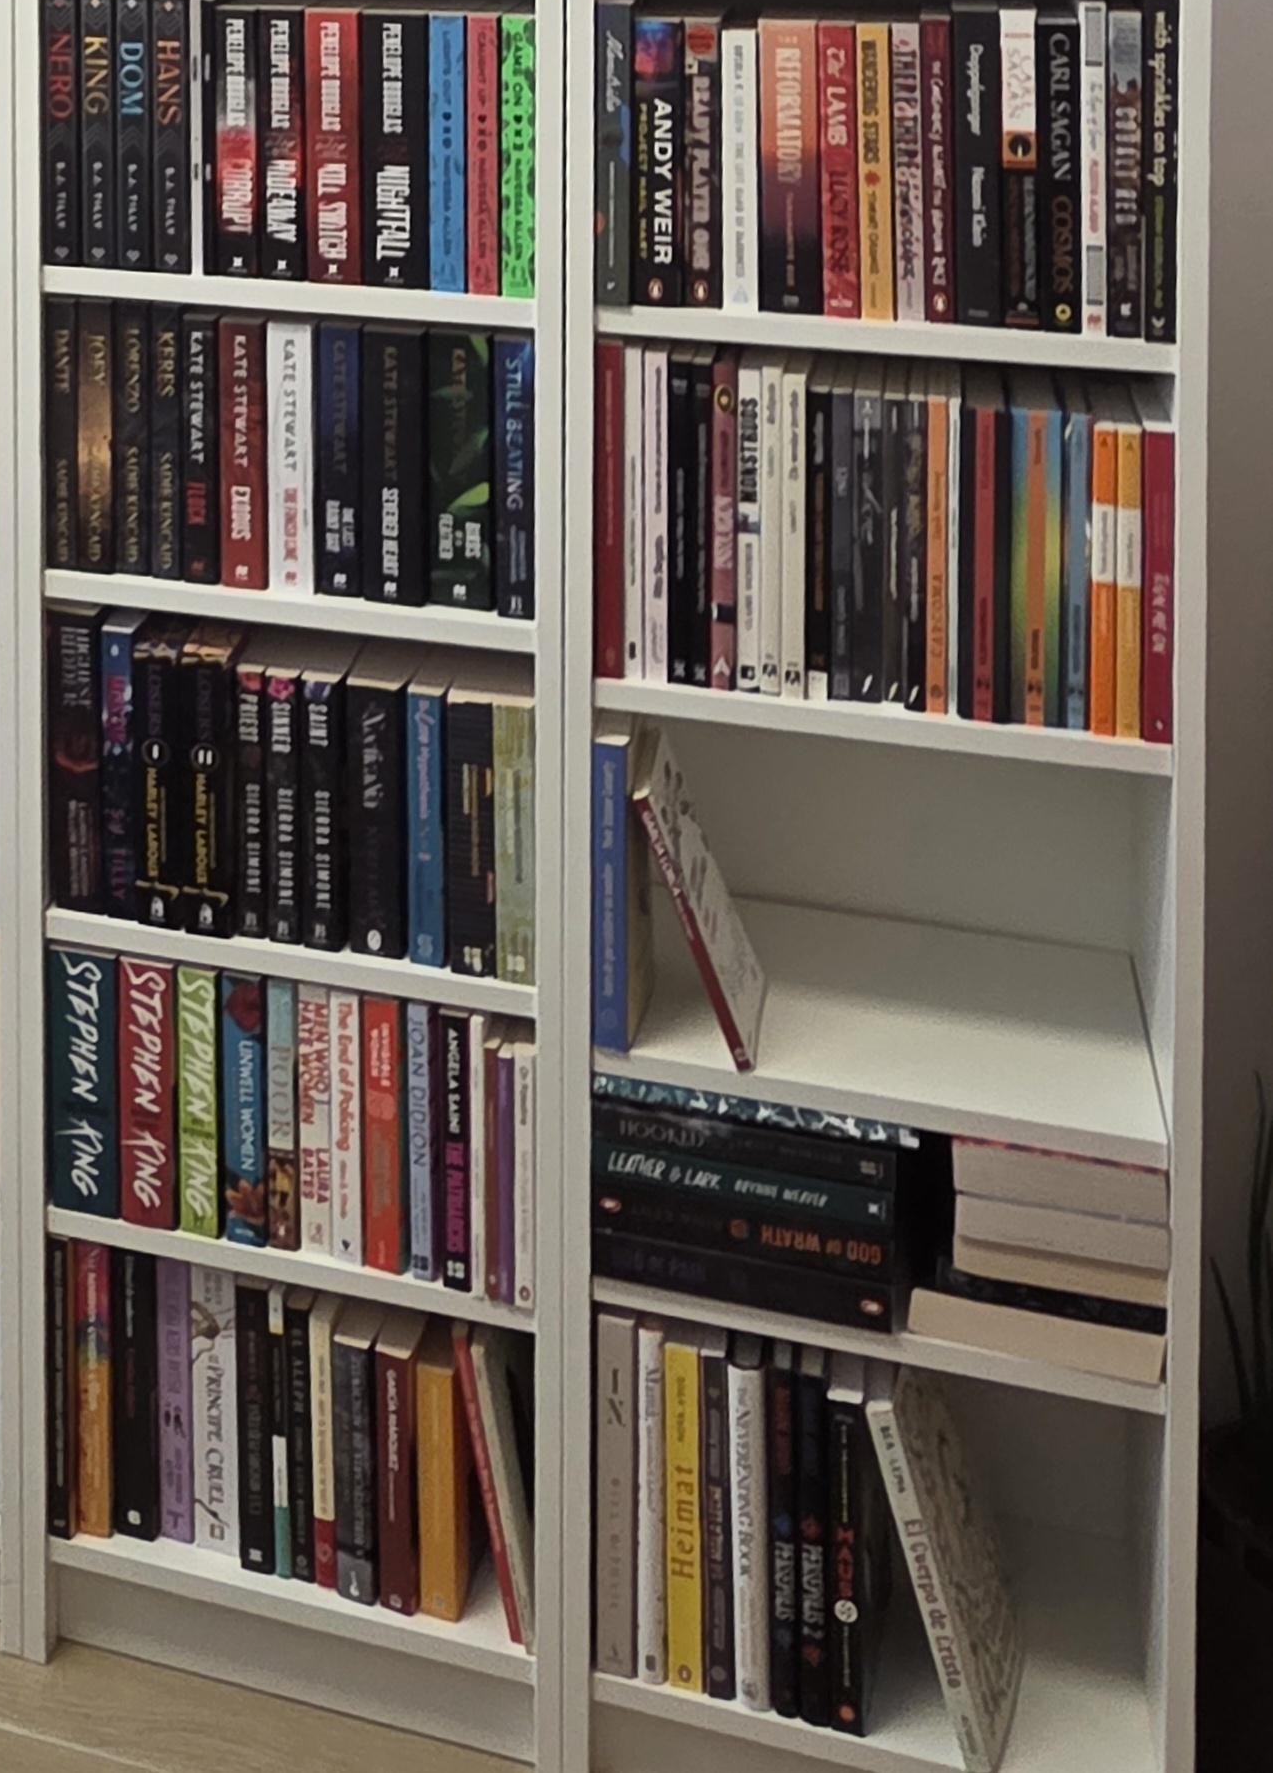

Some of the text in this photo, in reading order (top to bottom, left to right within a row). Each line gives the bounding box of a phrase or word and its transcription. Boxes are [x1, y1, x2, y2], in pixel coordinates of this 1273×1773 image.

[50, 32, 74, 119] NERO
[84, 36, 108, 115] KING
[119, 41, 144, 115] DOM
[157, 40, 182, 126] HANS
[828, 86, 848, 146] LAMB
[318, 162, 346, 258] KILL SWITCH
[377, 165, 410, 261] NIGHTFALL
[654, 98, 673, 264] ANDY WEIR
[1049, 33, 1072, 293] CARL SAGAN COSMOS
[189, 330, 204, 464] KATE STEWART
[233, 333, 248, 468] KATE STEWART
[506, 358, 524, 510] STILL BEATING
[308, 704, 329, 747] SAINT
[56, 953, 104, 1197] STEPHEN KING
[121, 958, 167, 1208] STEPHEN KING
[178, 969, 217, 1218] STEPHEN KING
[238, 1039, 256, 1171] UNWELL WOMEN
[333, 1089, 354, 1151] Policing
[408, 1016, 427, 1165] JOAN DIDION
[670, 1464, 695, 1580] Heimat
